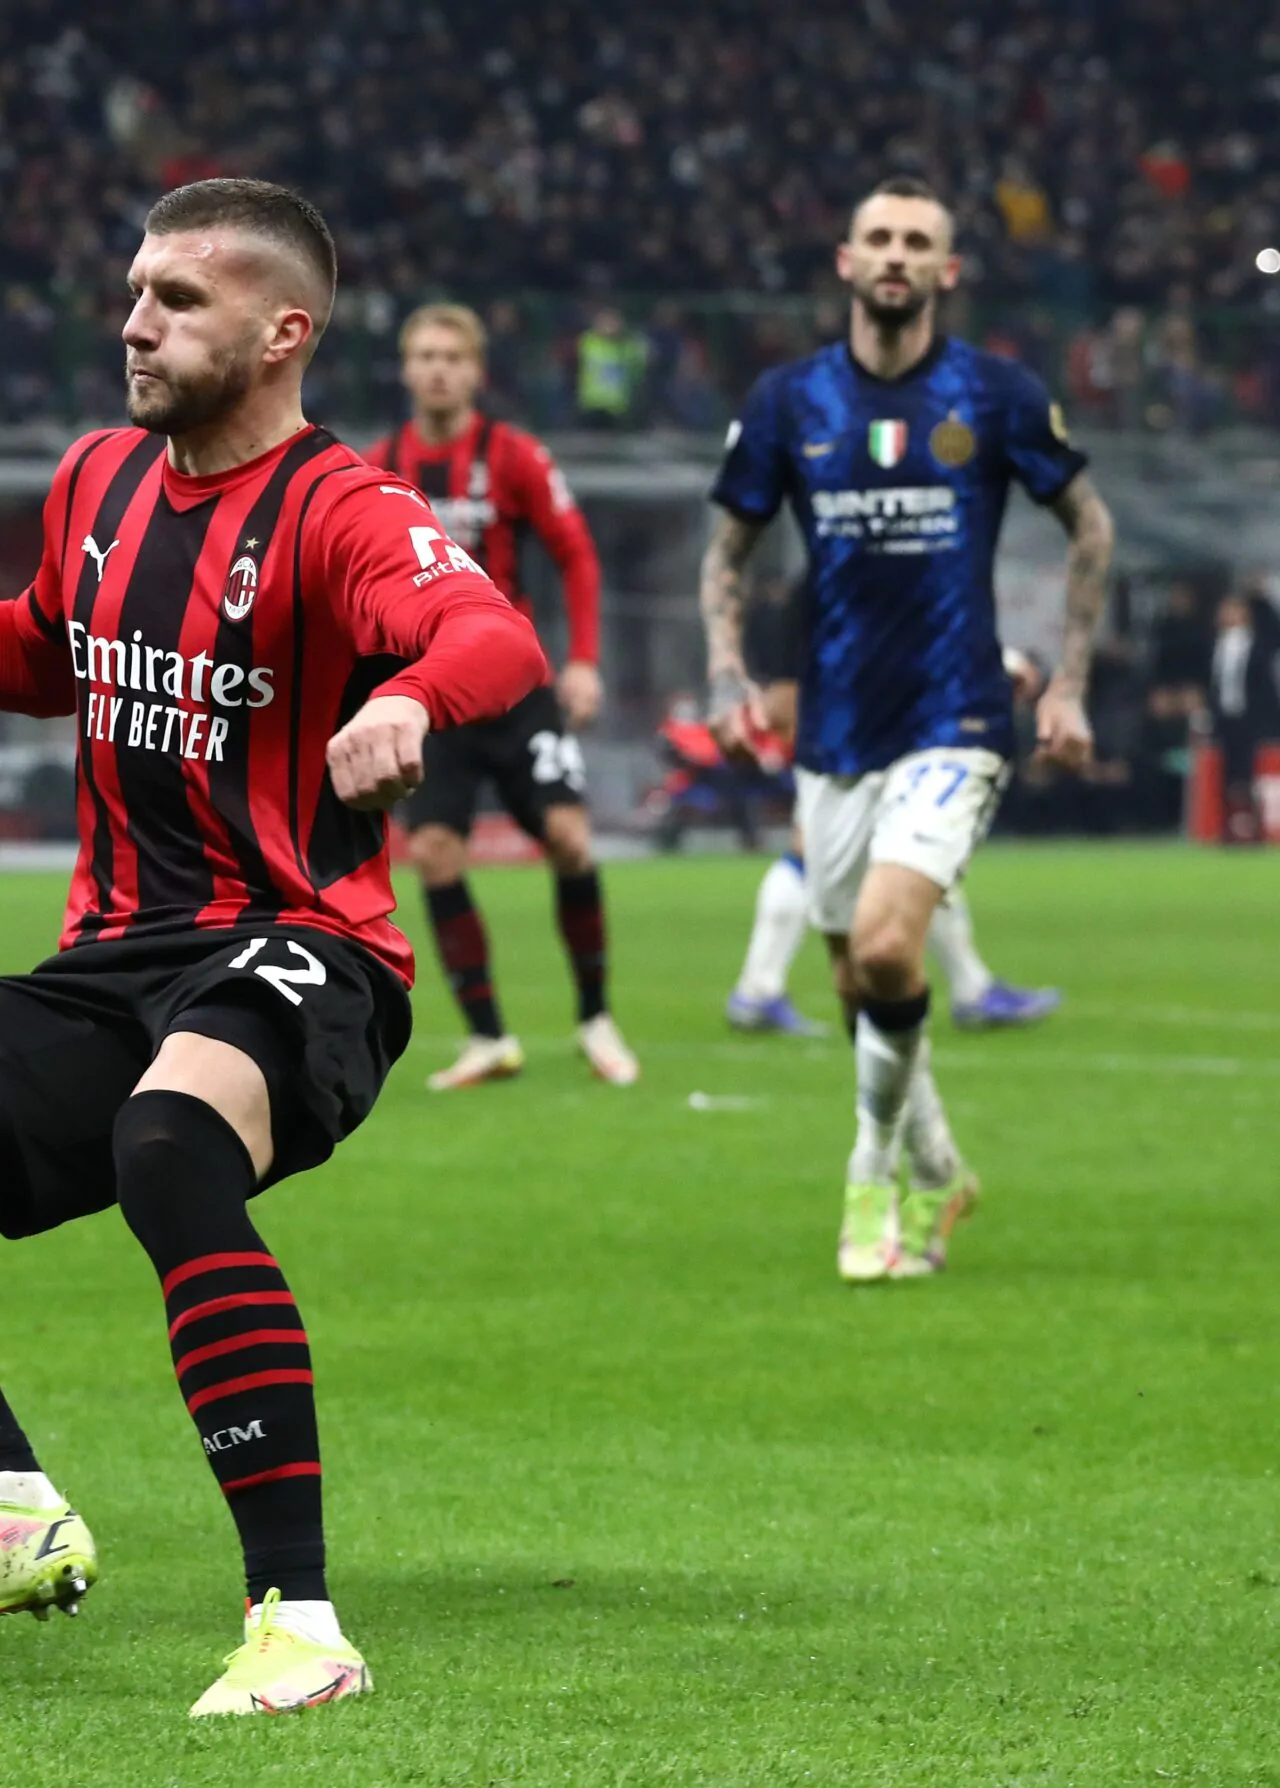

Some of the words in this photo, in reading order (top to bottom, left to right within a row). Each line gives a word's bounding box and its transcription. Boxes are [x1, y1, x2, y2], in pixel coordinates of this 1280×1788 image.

[68, 620, 275, 708] Emirates
[87, 693, 123, 743] FLY
[127, 700, 229, 762] BETTER
[227, 937, 327, 1006] 12
[203, 1419, 267, 1455] ACM
